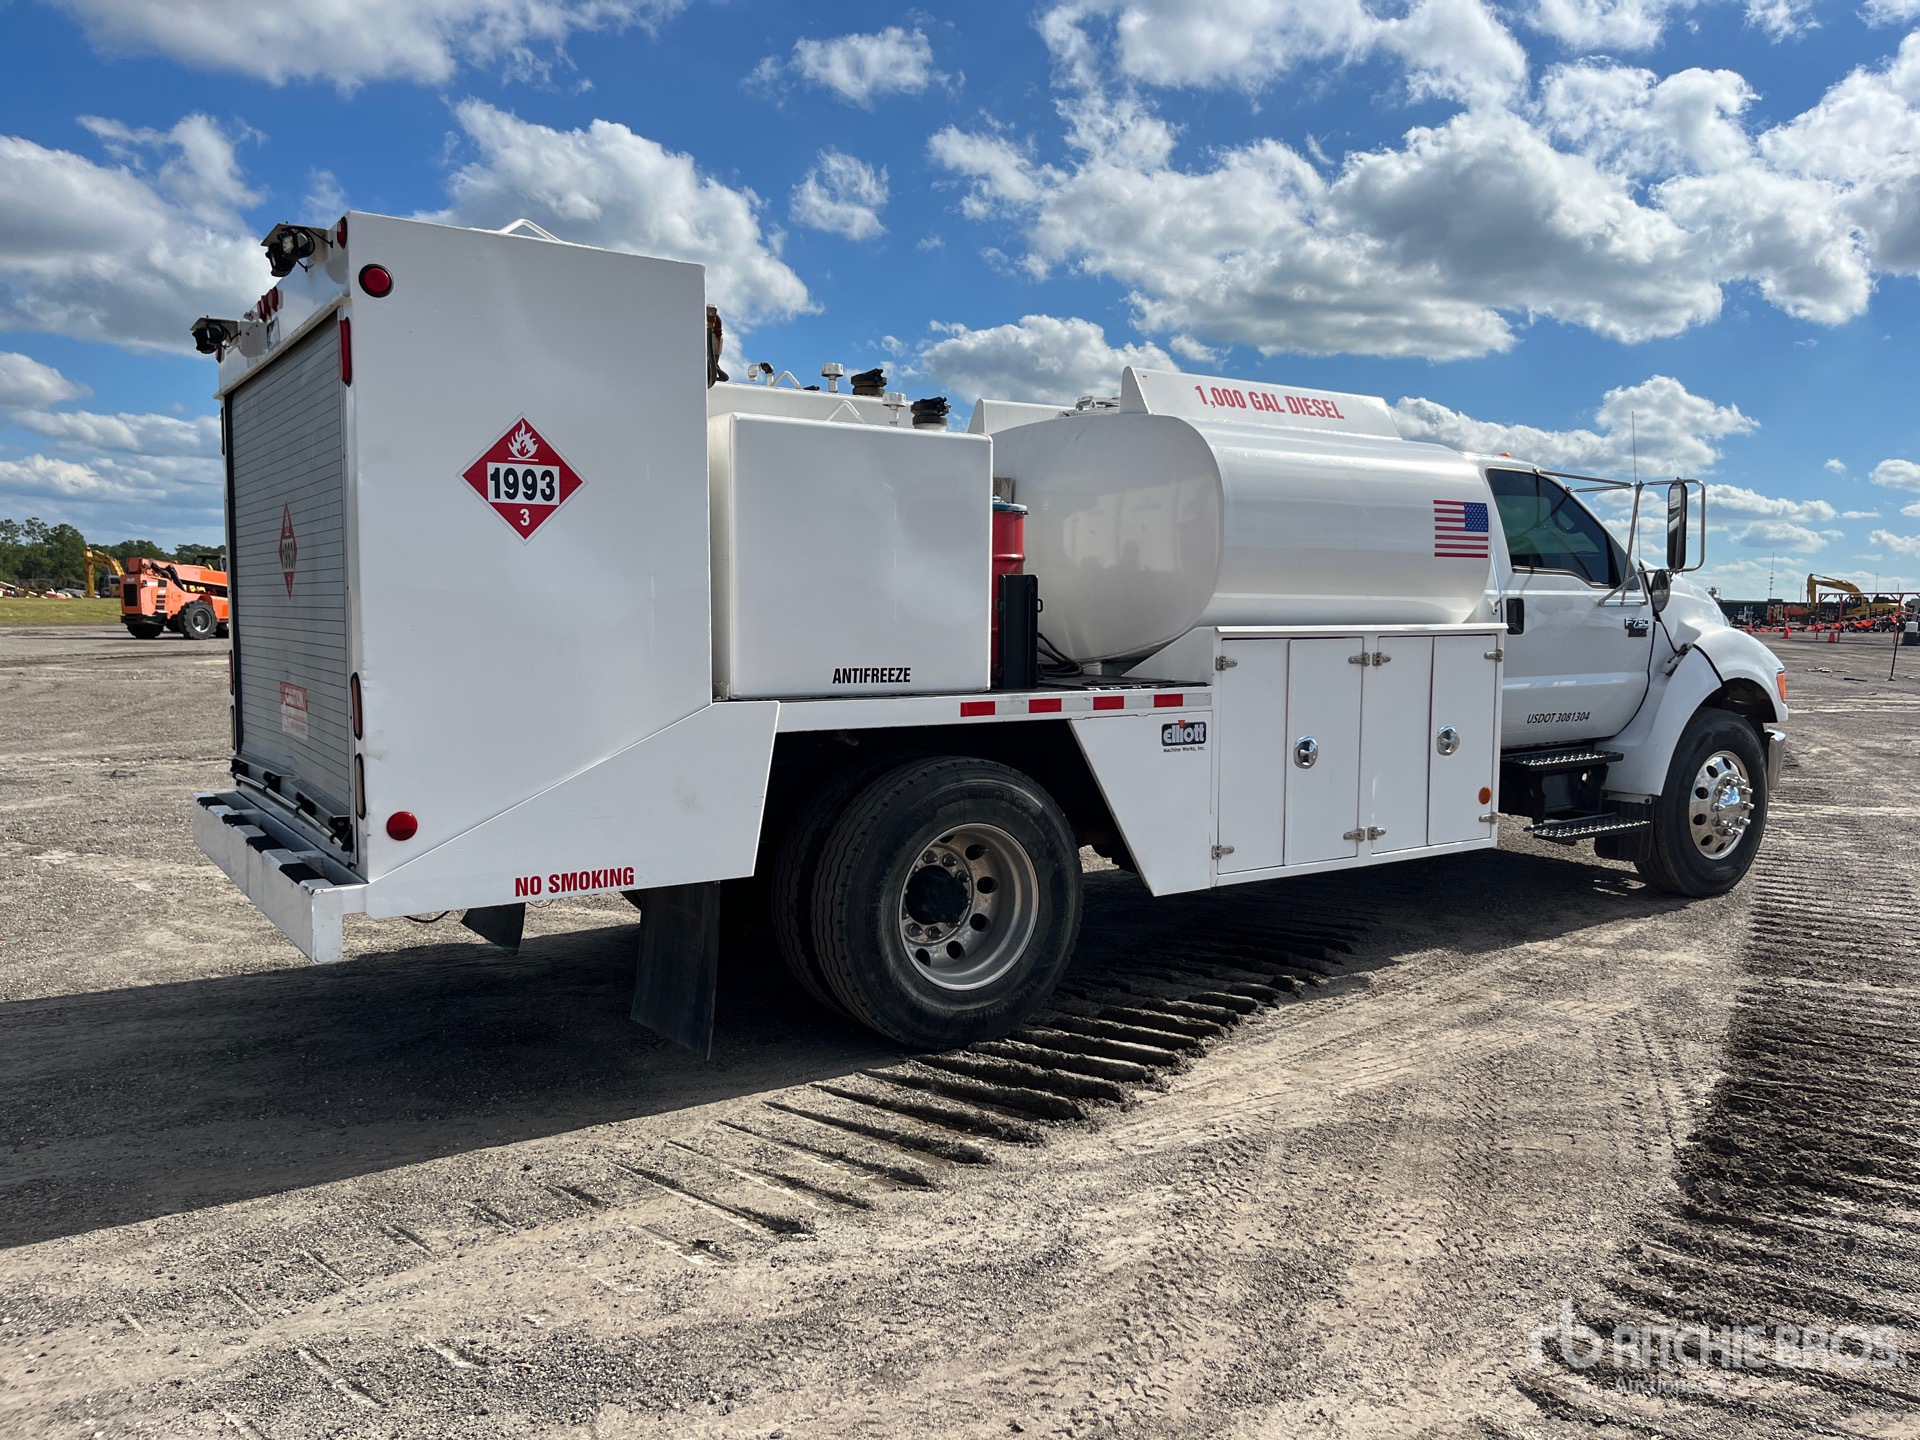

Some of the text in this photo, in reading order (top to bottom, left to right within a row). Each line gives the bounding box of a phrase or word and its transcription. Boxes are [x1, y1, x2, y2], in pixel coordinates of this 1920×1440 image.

[1194, 385, 1345, 419] 1,000 GAL DIESEL
[489, 466, 556, 502] 1993
[519, 508, 531, 526] 3
[832, 667, 911, 684] ANTIFREEZE
[1526, 711, 1591, 724] USDOT 3081304
[515, 866, 635, 897] NO SMOKING
